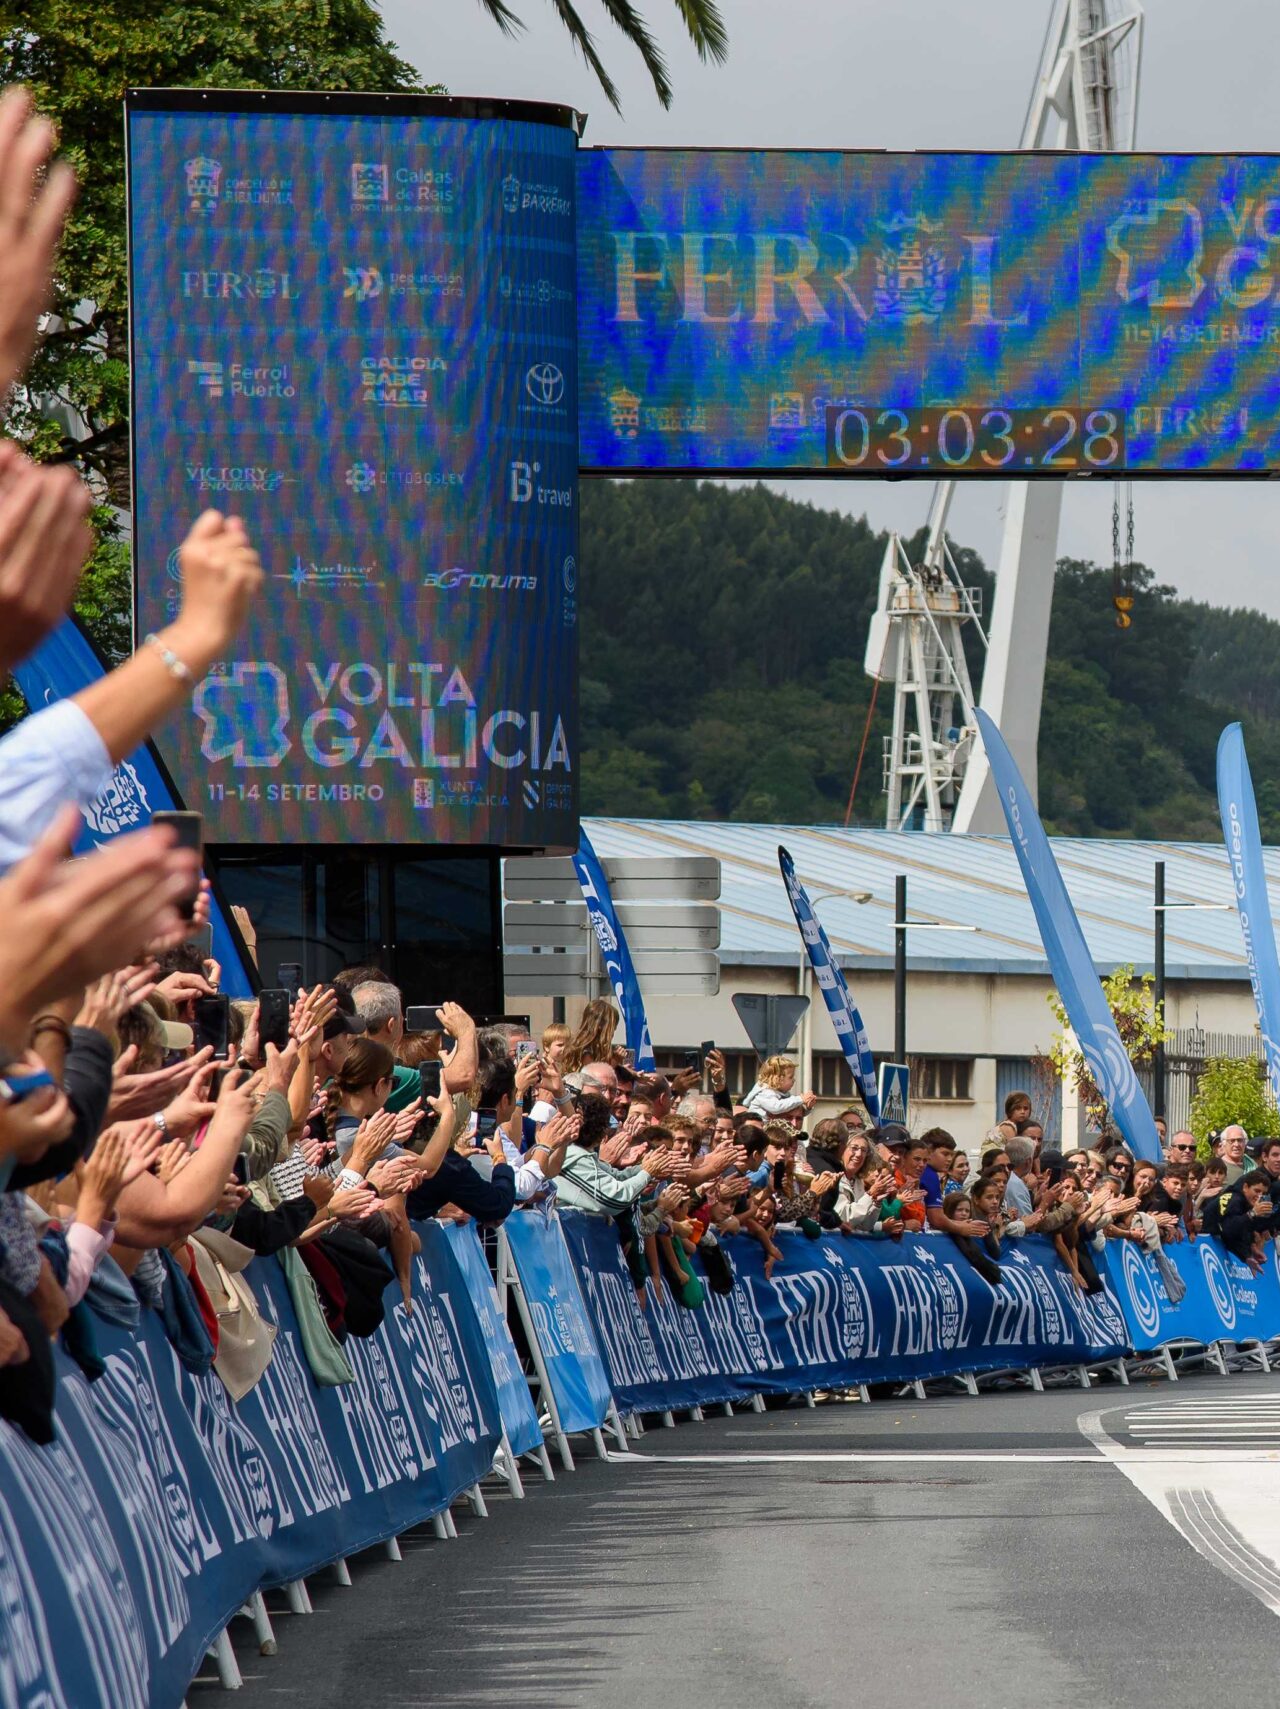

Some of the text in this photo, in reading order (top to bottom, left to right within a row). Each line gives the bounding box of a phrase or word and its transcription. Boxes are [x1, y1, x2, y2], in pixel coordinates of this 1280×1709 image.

[395, 168, 453, 185] Caldas
[418, 186, 453, 201] Reis
[230, 363, 287, 380] Ferrol
[361, 357, 447, 371] GALICIA
[230, 382, 295, 398] Puerto
[361, 389, 428, 402] AMAR
[833, 408, 1119, 467] 03:03:28
[538, 486, 572, 507] travel
[305, 662, 477, 707] VOLTA
[301, 707, 572, 773] GALICIA
[208, 784, 385, 801] 11-14 SETEMBRO
[1229, 802, 1247, 899] Galego
[1232, 1283, 1258, 1310] Galego
